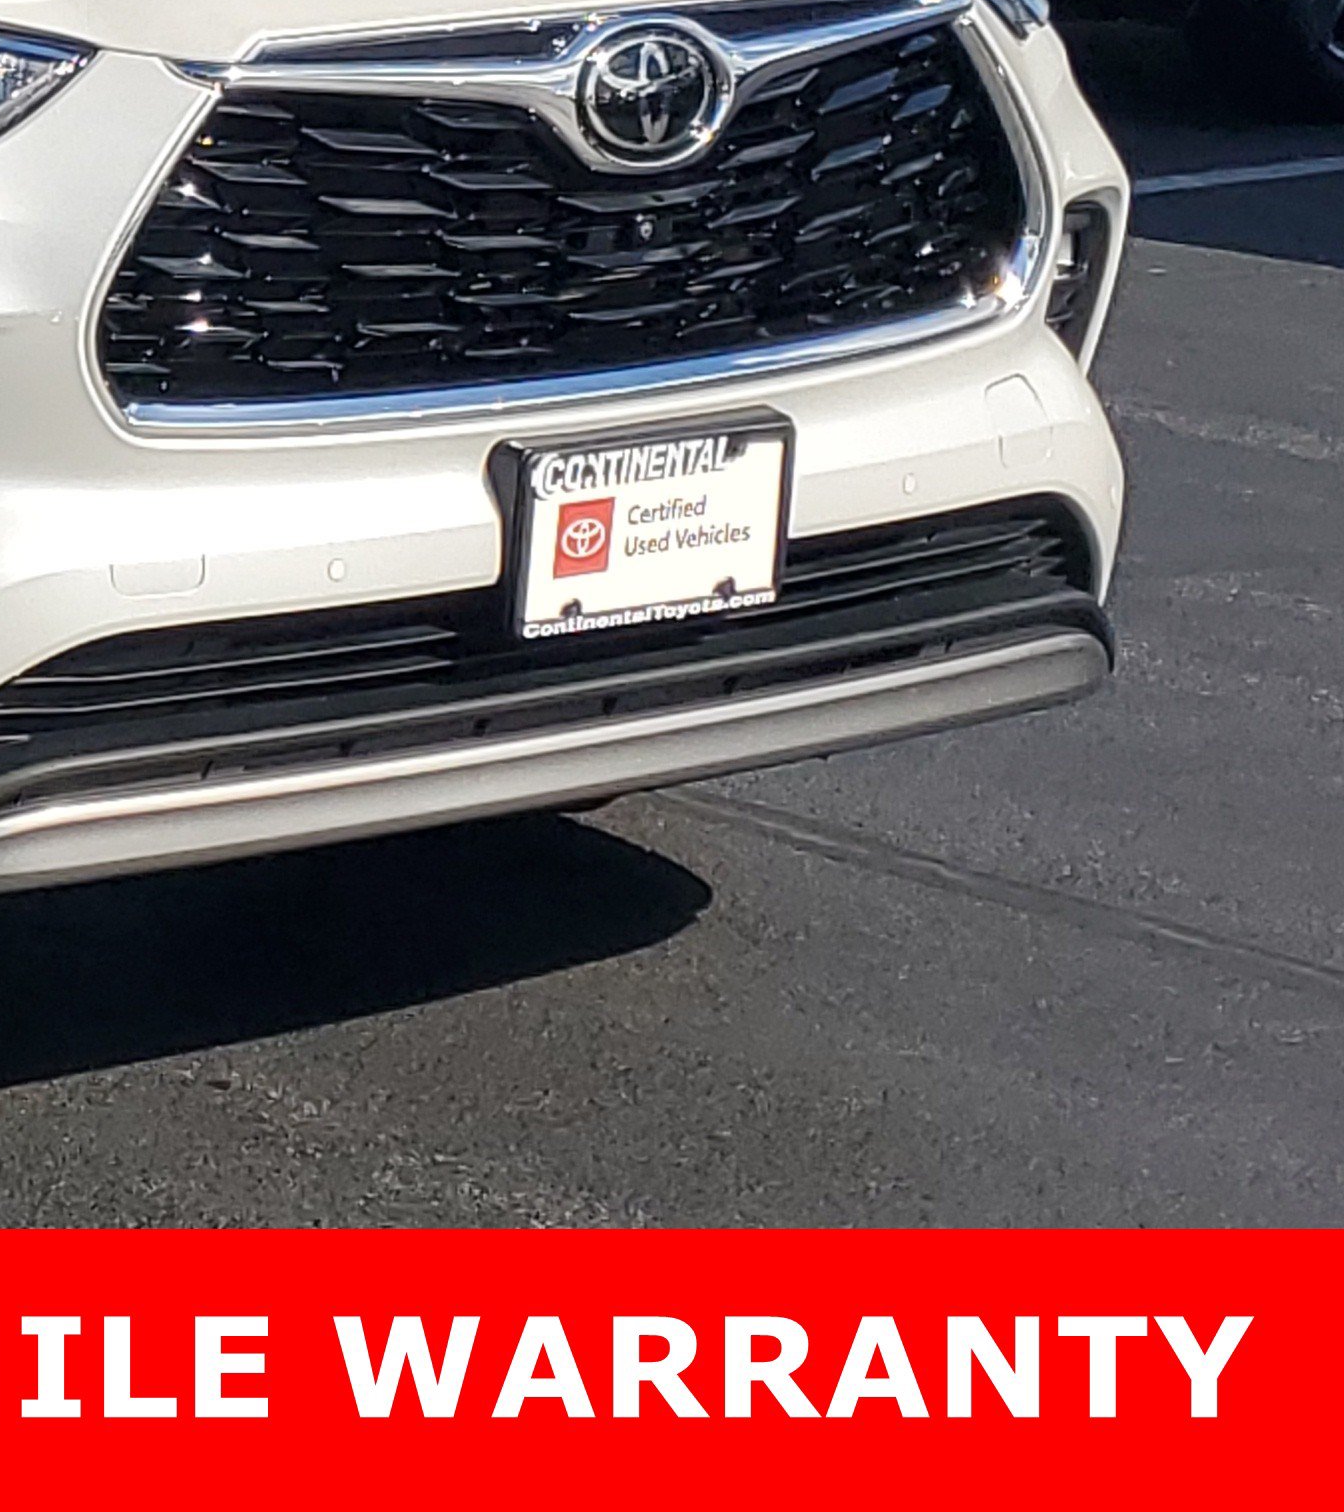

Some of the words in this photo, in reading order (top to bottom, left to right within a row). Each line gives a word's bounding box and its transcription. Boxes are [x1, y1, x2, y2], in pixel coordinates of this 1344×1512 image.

[543, 436, 729, 492] CONTINENTAL
[628, 495, 707, 525] Certified
[624, 530, 671, 556] Used
[676, 524, 751, 550] Vehicles
[522, 590, 776, 639] ContinentalToyota.com
